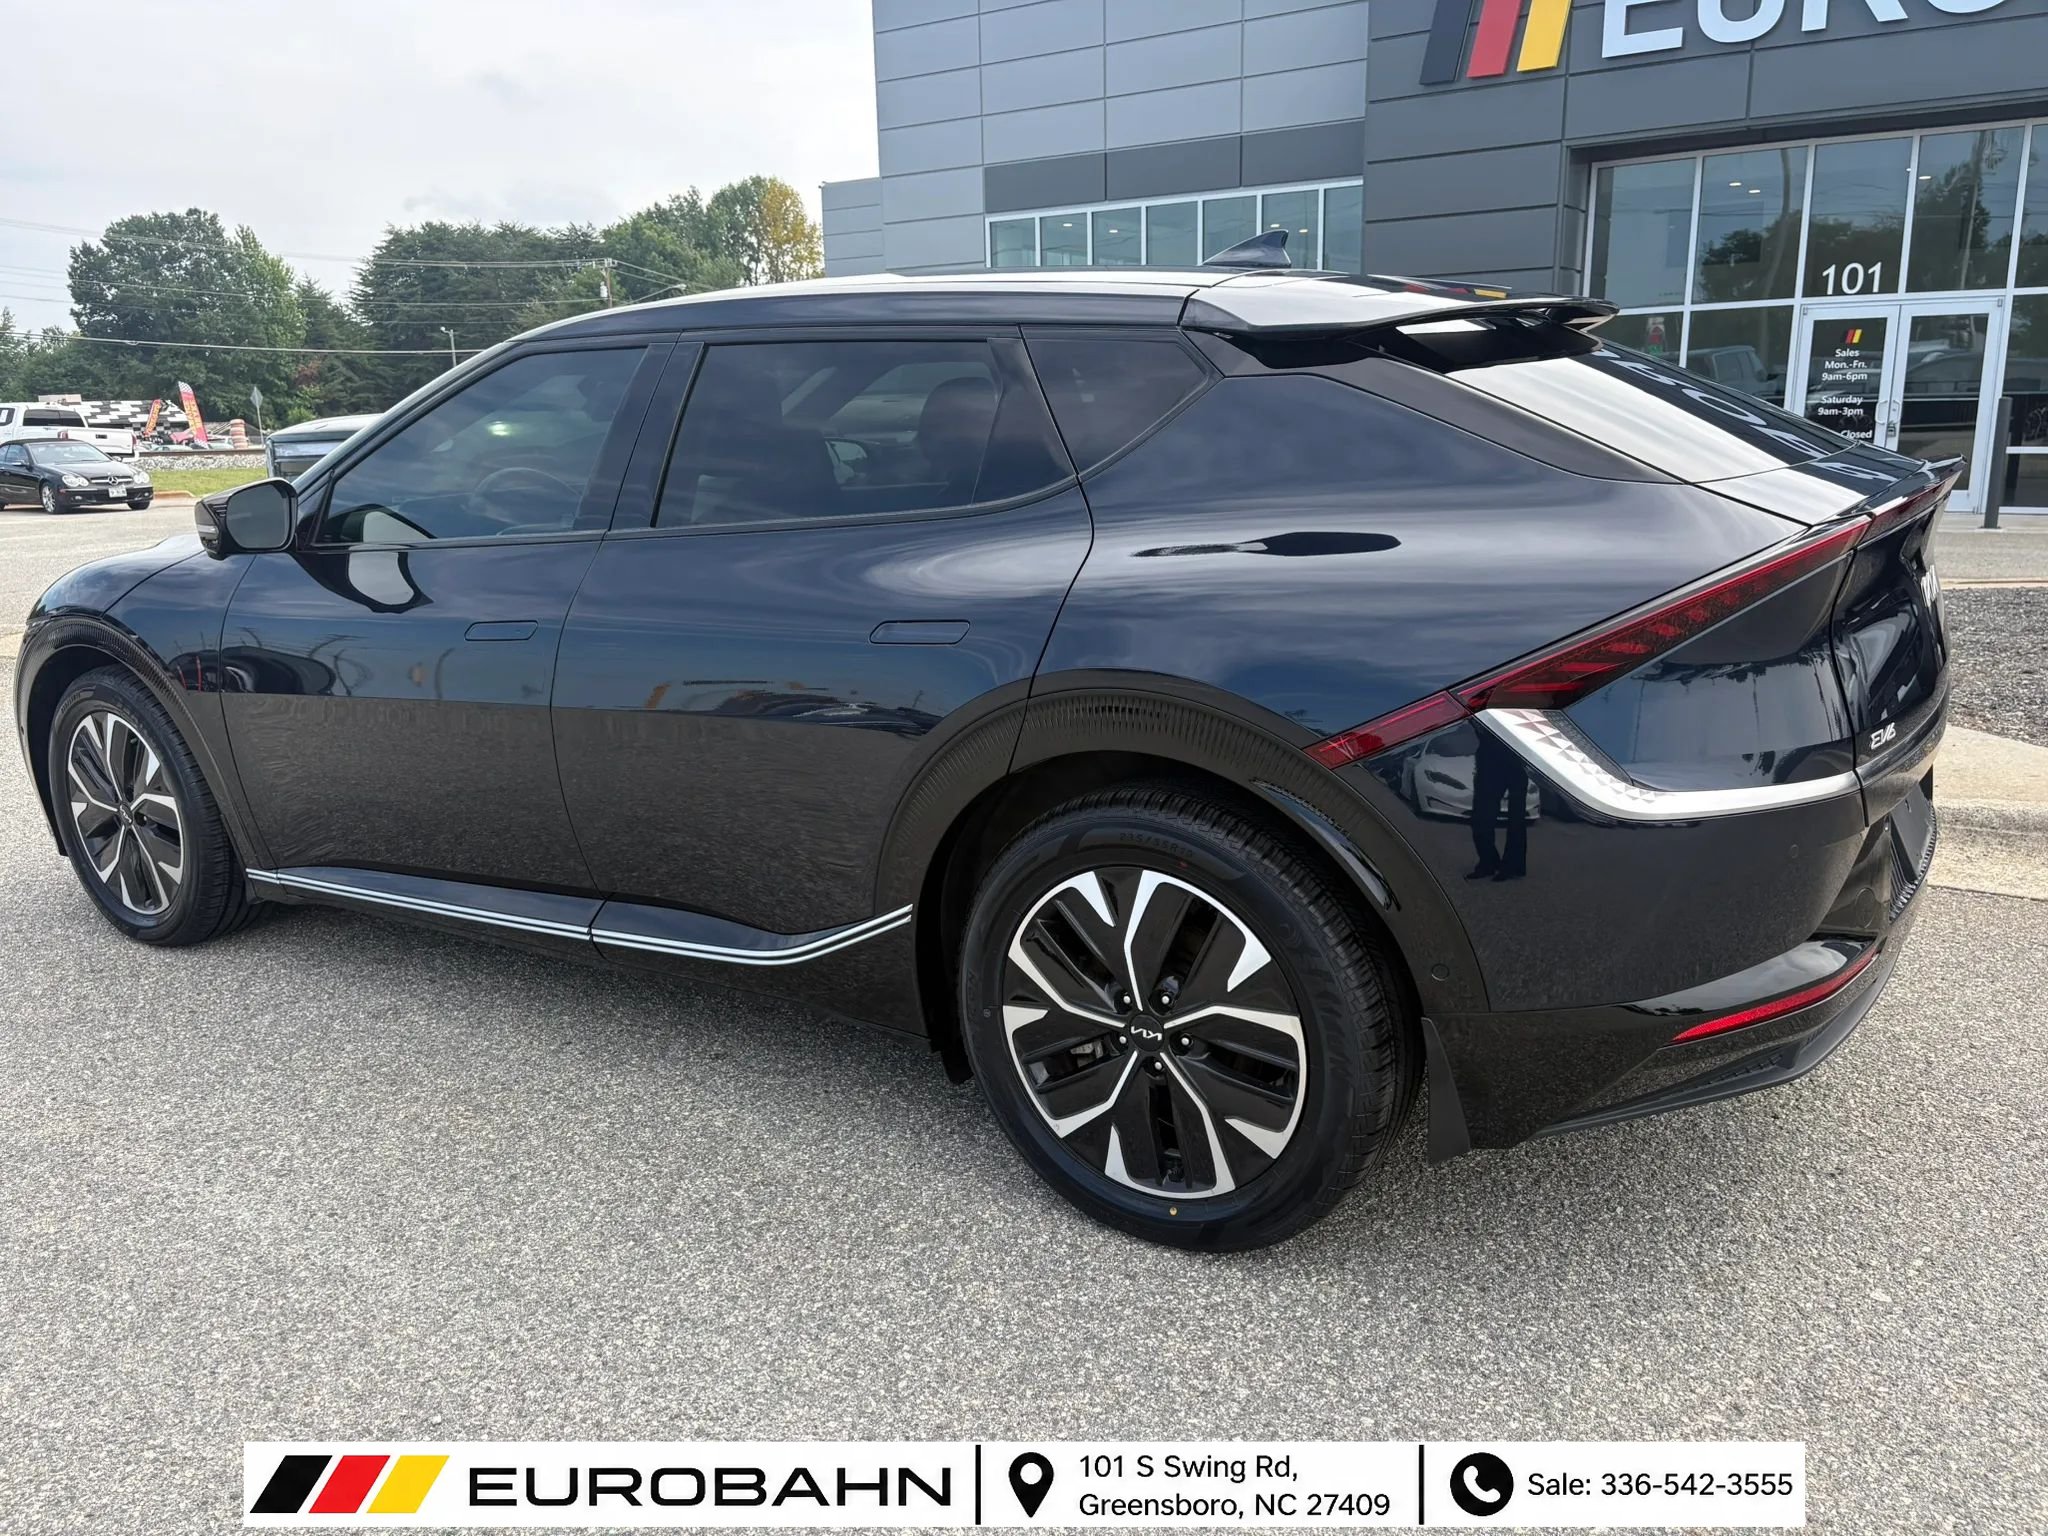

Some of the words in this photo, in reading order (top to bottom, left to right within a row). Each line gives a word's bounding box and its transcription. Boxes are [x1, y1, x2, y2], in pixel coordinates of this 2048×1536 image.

[1822, 261, 1882, 295] 101
[1835, 348, 1860, 358] Sales
[1822, 372, 1868, 382] 9am-6pm
[1822, 395, 1864, 405] Saturday
[1818, 407, 1864, 417] 9am-3pm
[1840, 430, 1873, 439] Closed
[1870, 722, 1897, 750] EV6
